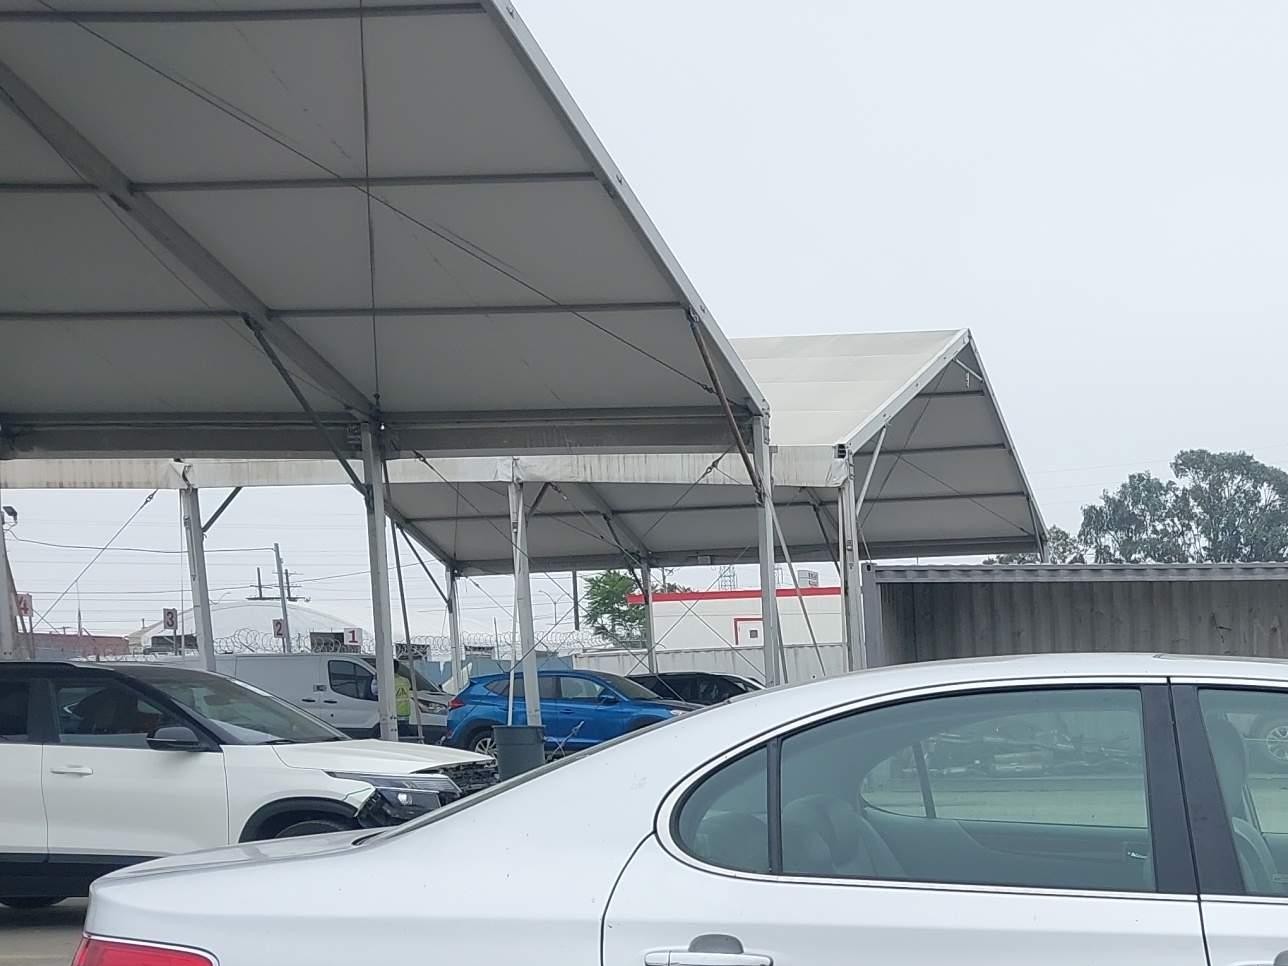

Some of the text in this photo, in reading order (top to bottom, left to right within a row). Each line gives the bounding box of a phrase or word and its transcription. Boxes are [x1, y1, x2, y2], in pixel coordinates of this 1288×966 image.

[18, 596, 29, 614] 4
[166, 611, 175, 628] 3
[275, 621, 284, 637] 2
[347, 629, 358, 643] 1
